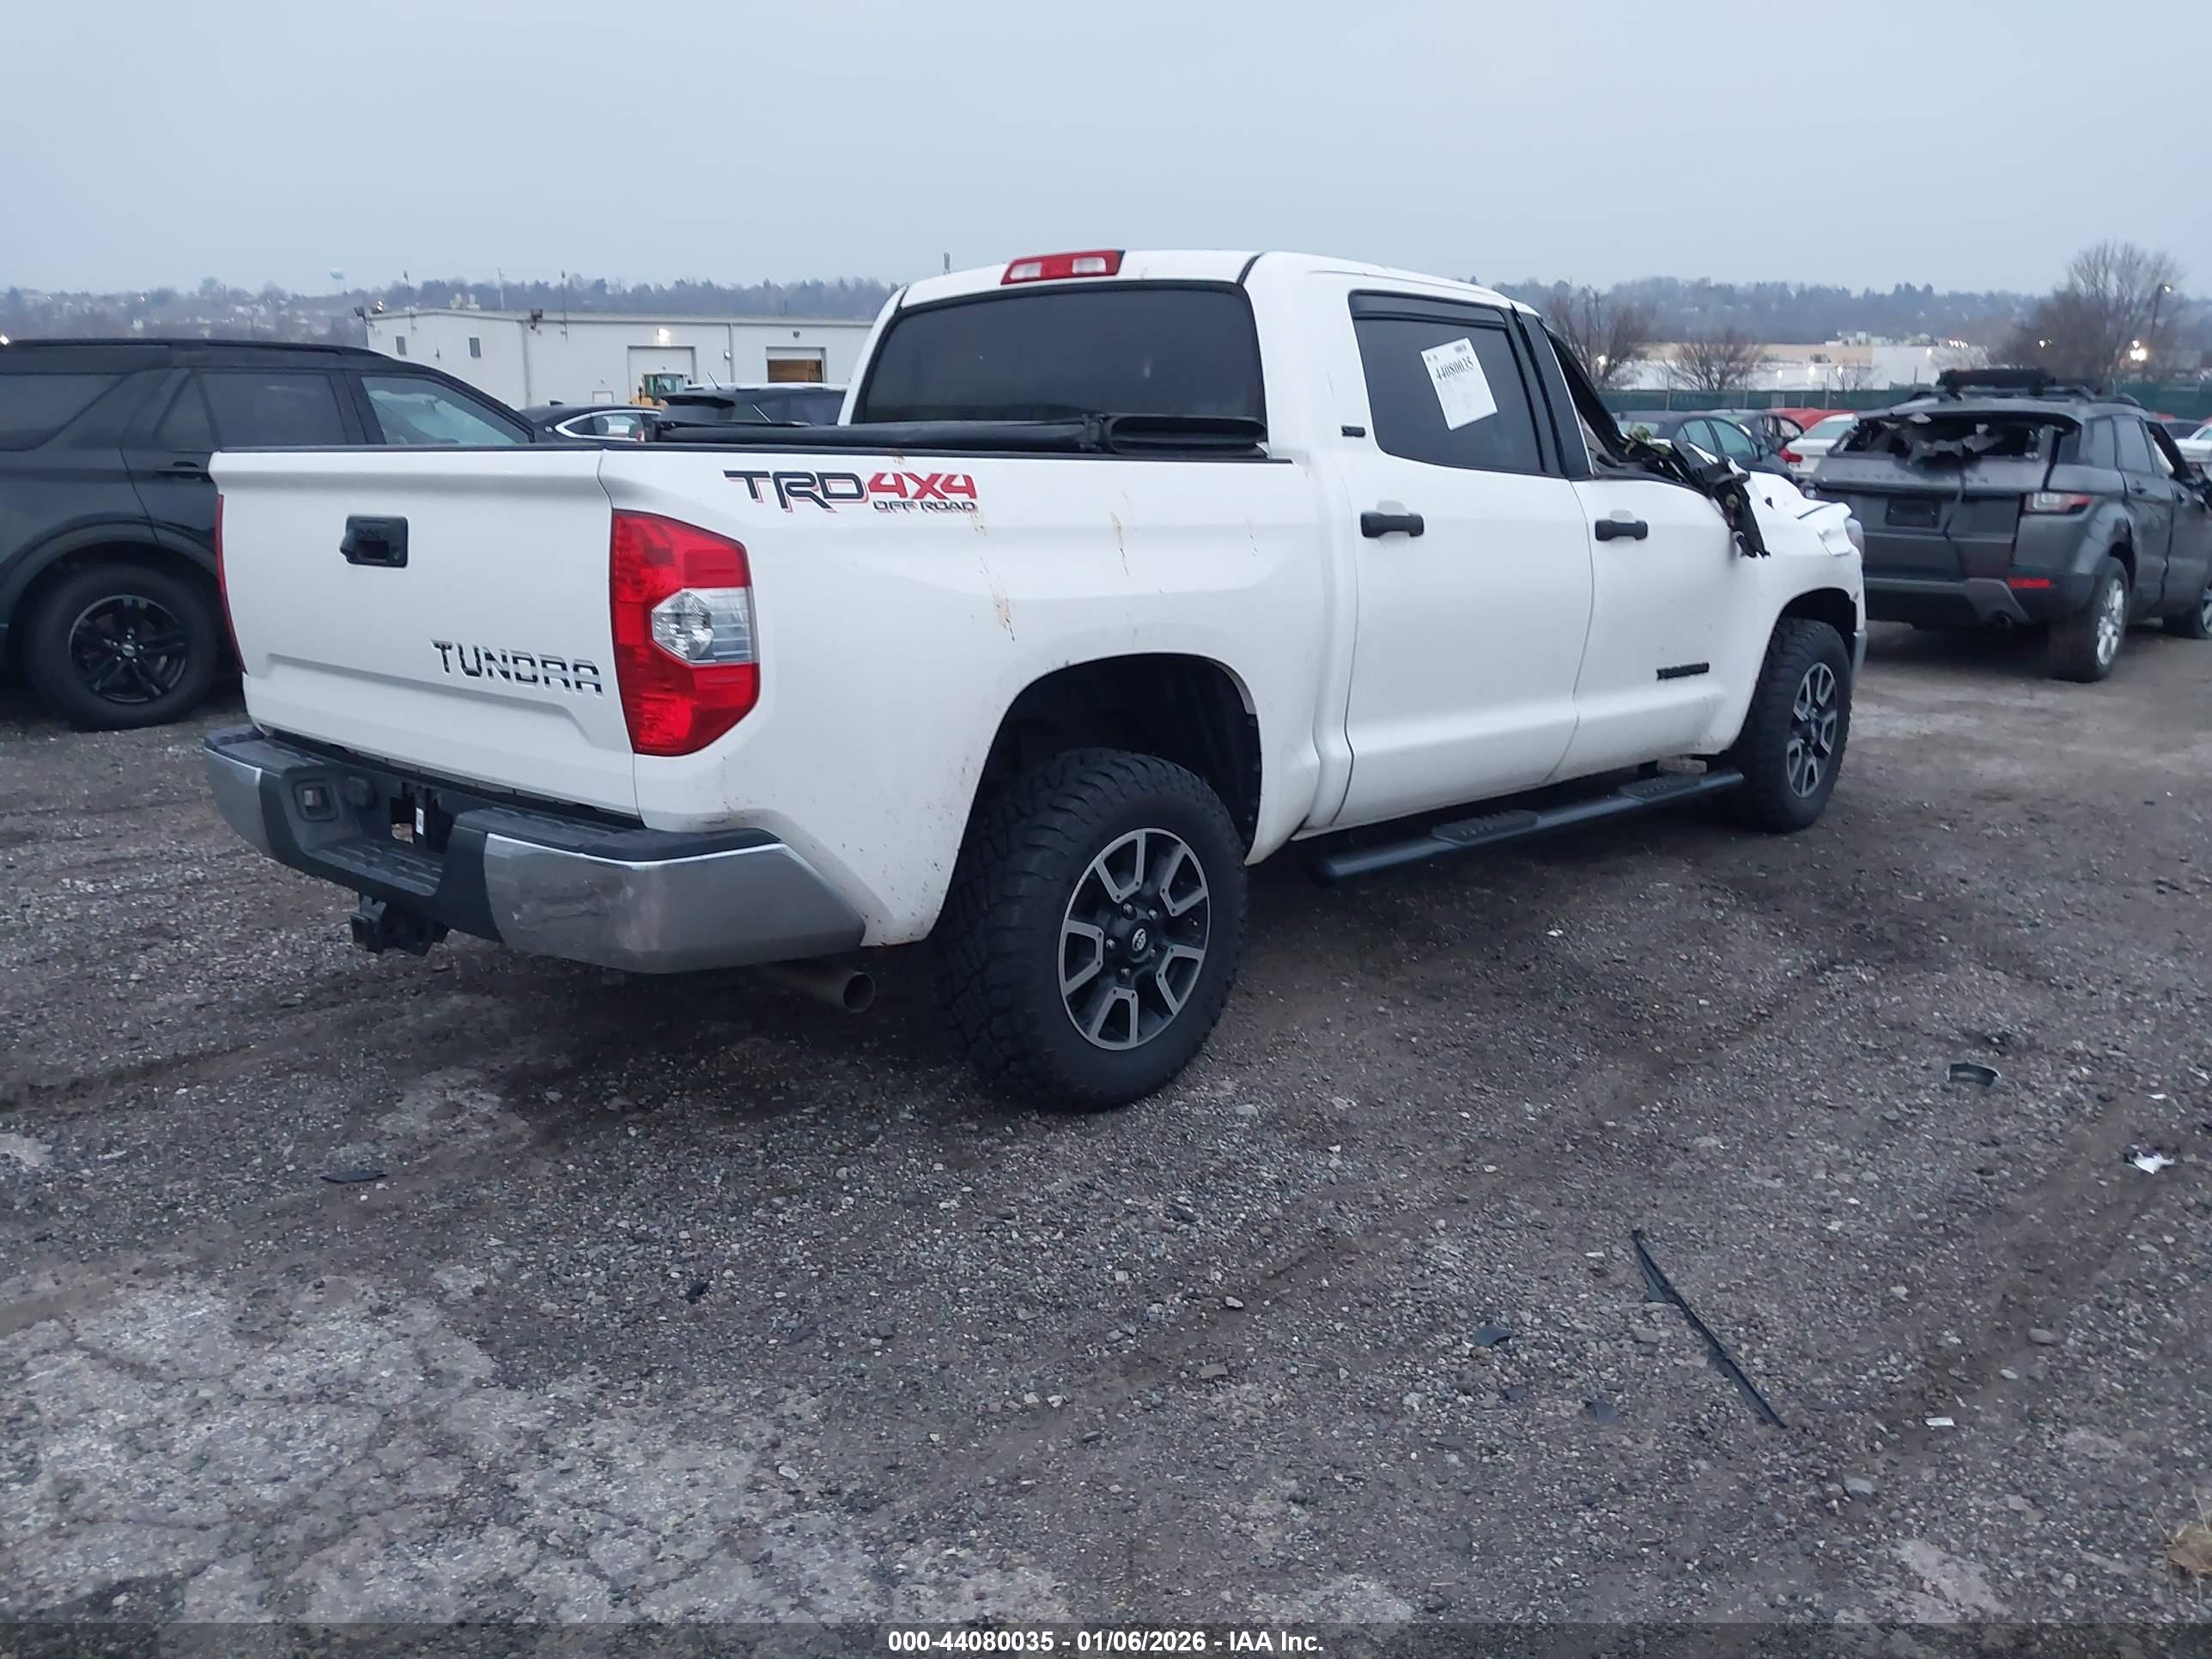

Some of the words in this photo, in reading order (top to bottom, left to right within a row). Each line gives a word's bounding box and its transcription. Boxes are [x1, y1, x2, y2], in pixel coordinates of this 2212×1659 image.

[723, 470, 868, 513] TRD
[872, 501, 915, 513] OFF
[918, 501, 977, 513] ROAD
[430, 639, 603, 697] TUNDRA
